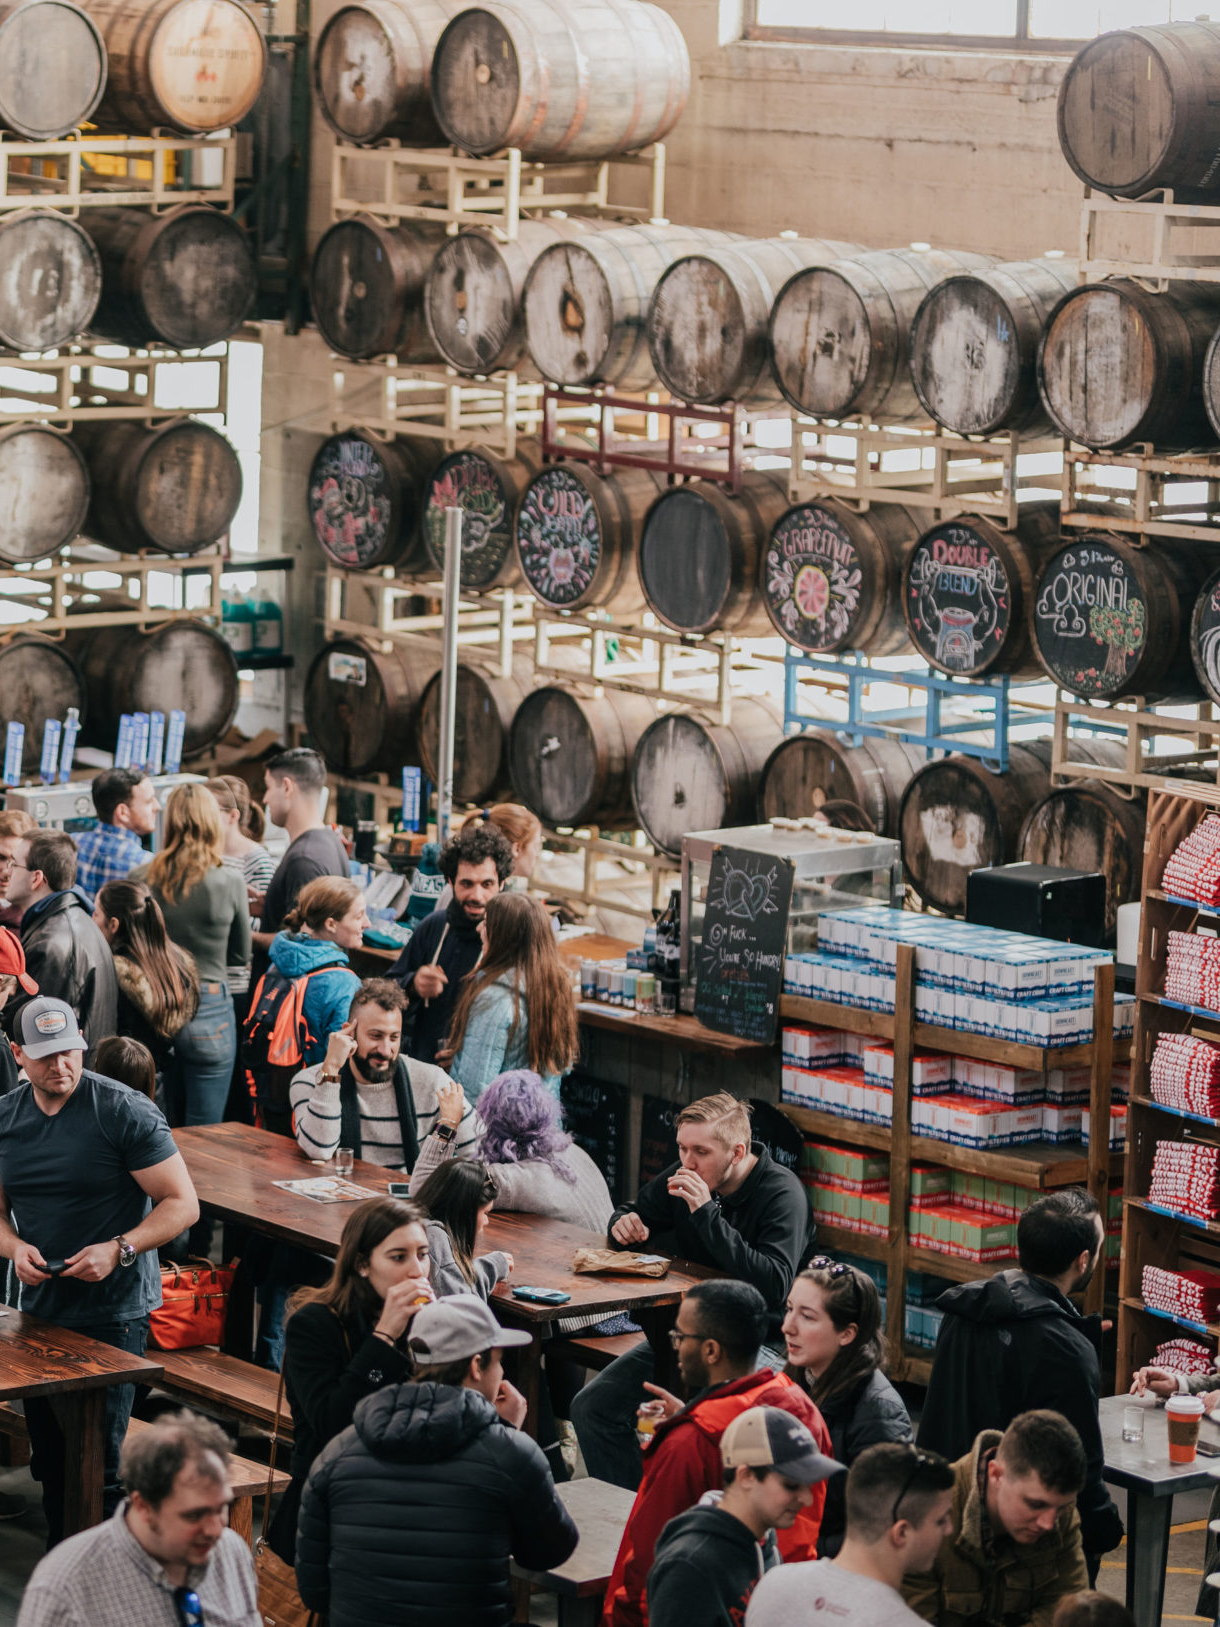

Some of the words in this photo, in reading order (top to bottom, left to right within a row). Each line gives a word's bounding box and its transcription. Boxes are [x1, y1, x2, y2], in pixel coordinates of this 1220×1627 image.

[783, 528, 855, 567] GRAPEFRUIT
[932, 539, 991, 568] DOUBLE
[939, 571, 978, 597] BLEND
[1052, 571, 1130, 615] ORIGINAL
